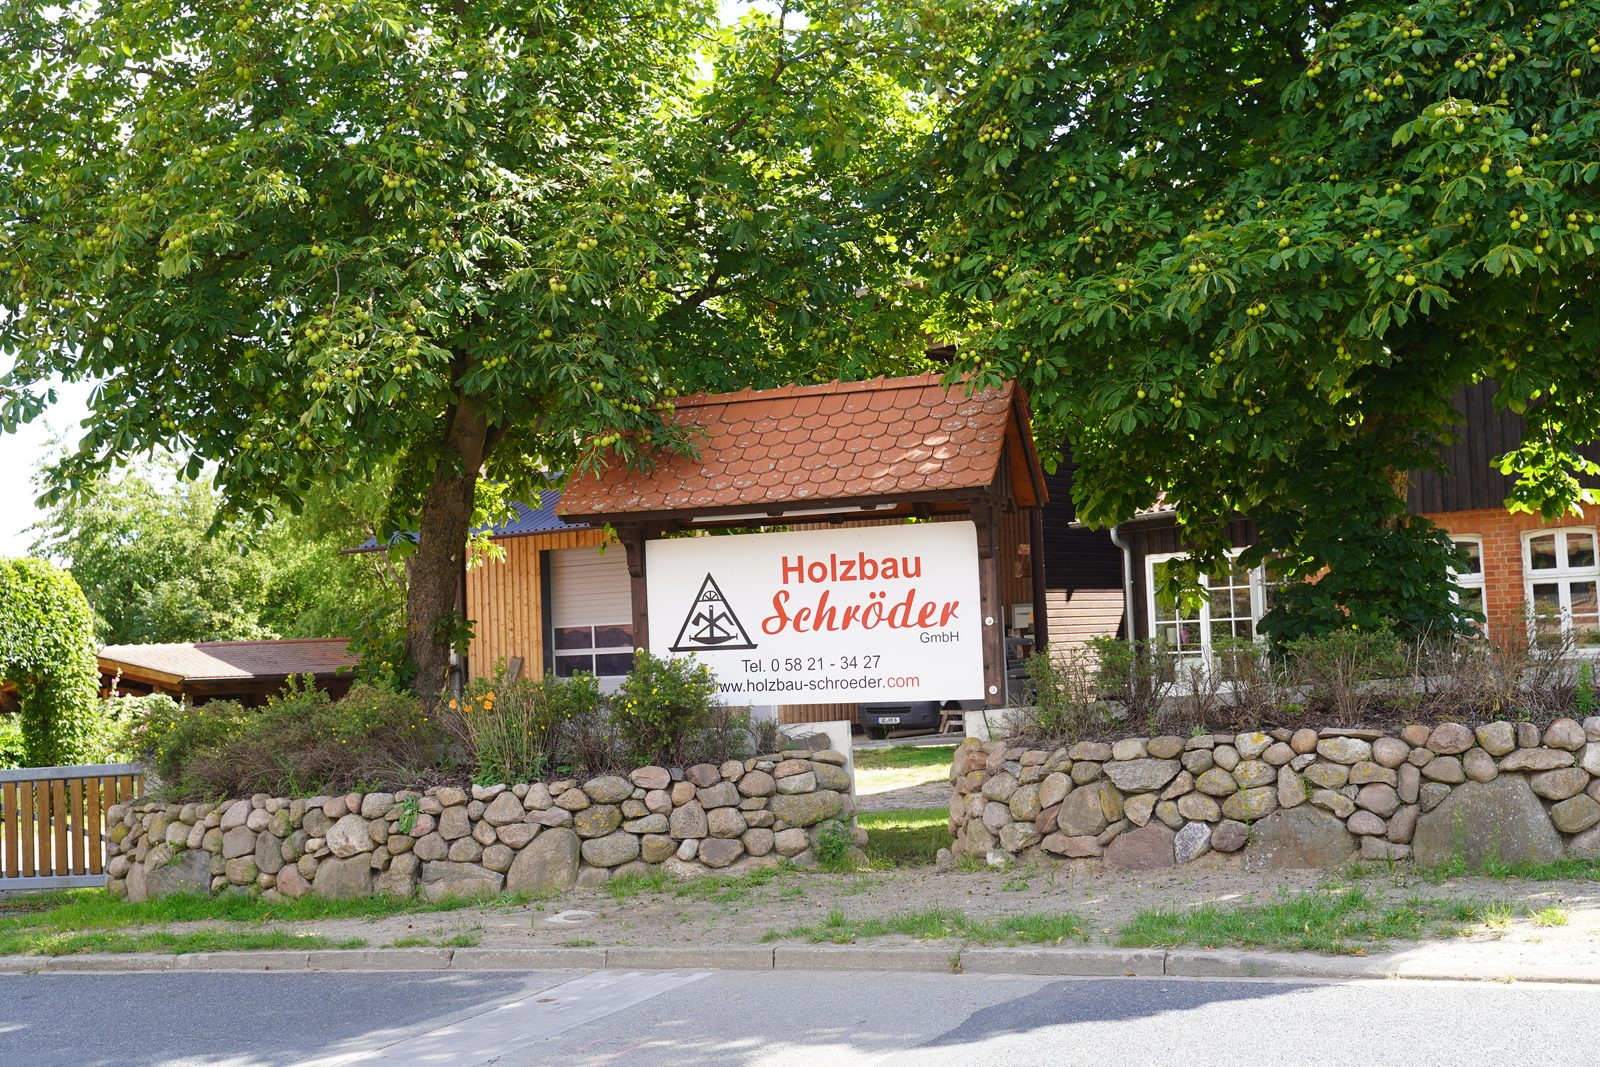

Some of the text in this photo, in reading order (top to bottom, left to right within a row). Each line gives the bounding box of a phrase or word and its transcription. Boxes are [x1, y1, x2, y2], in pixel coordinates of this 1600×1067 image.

[781, 552, 921, 585] Holzbau
[761, 587, 960, 635] Schröder
[919, 631, 960, 644] GmbH
[741, 659, 767, 673] Tel.
[770, 658, 780, 672] 0
[784, 658, 803, 672] 58
[807, 657, 824, 671] 21
[840, 656, 858, 670] 34
[863, 655, 881, 669] 27
[716, 675, 920, 693] ww.holzbau-schroeder.com
